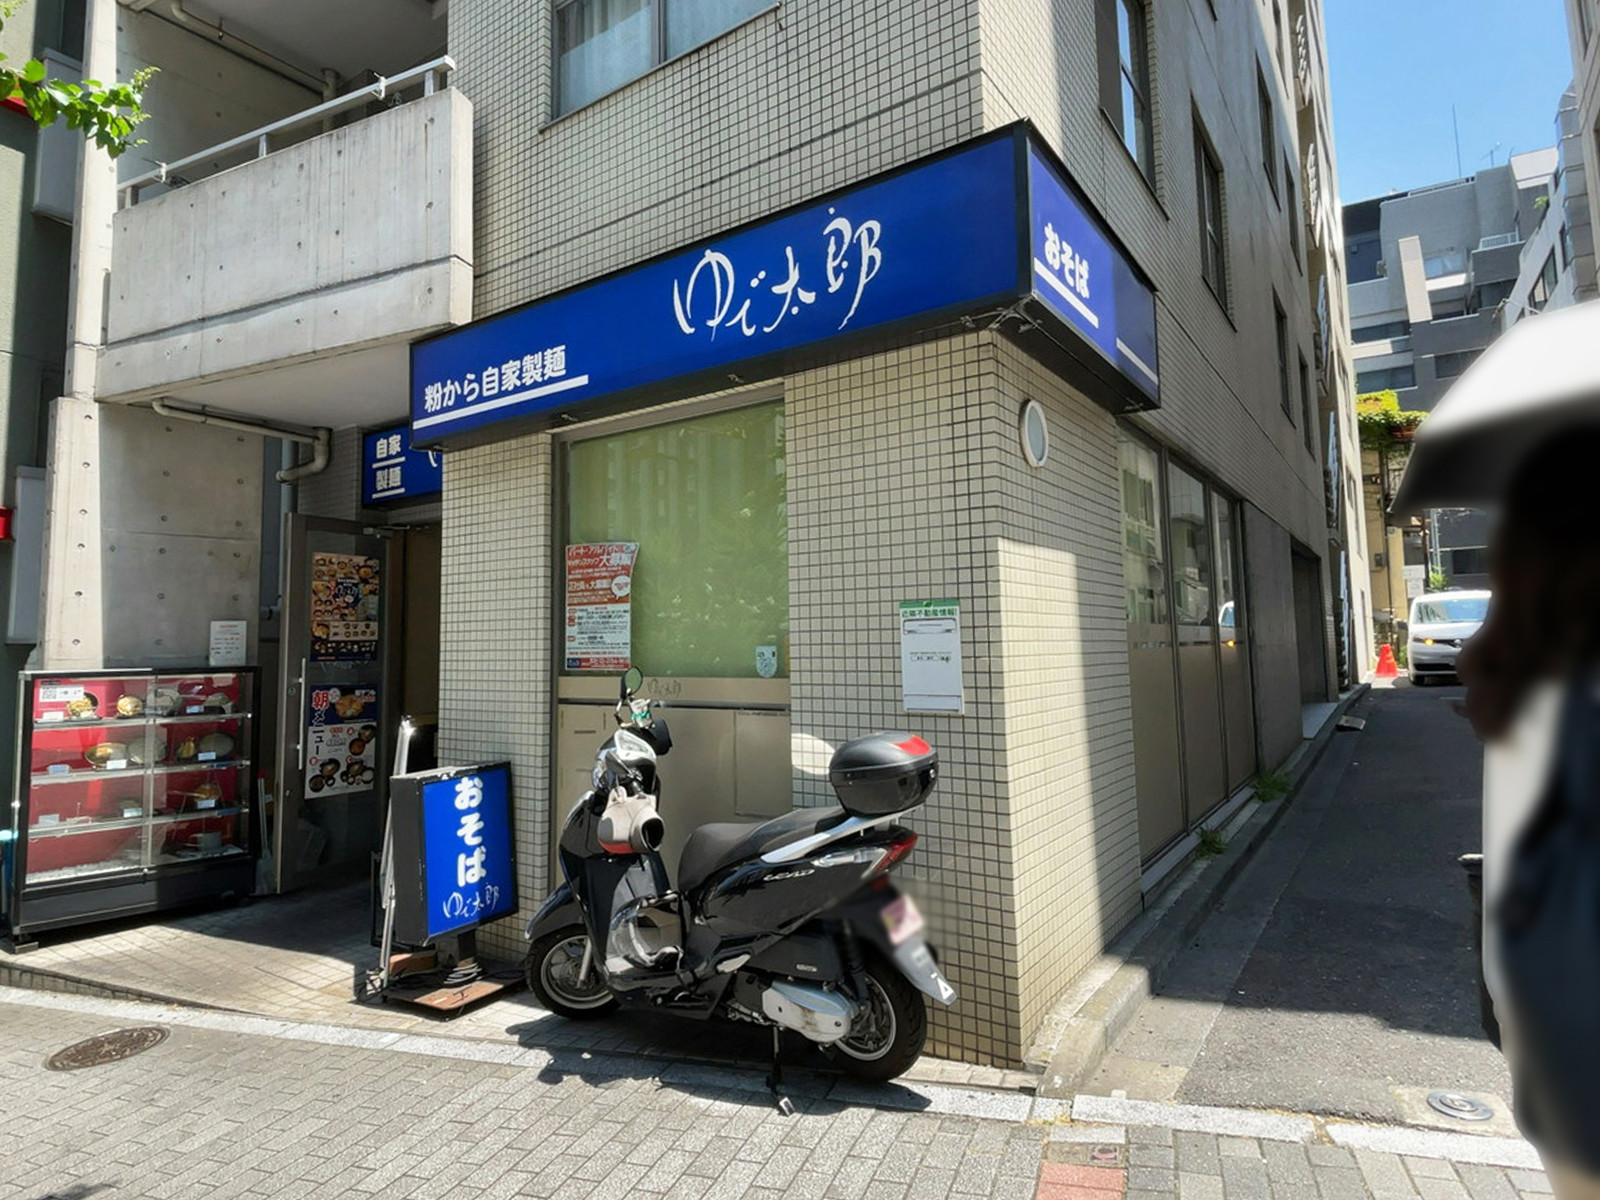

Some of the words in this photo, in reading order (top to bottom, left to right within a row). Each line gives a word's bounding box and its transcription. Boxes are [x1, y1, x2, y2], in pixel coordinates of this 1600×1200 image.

[673, 206, 882, 342] ゆで太郎
[1043, 222, 1090, 299] おそば
[424, 345, 567, 413] 粉から自家製麺
[375, 434, 402, 459] 自家
[375, 466, 402, 491] 製麺
[454, 776, 487, 888] おそば
